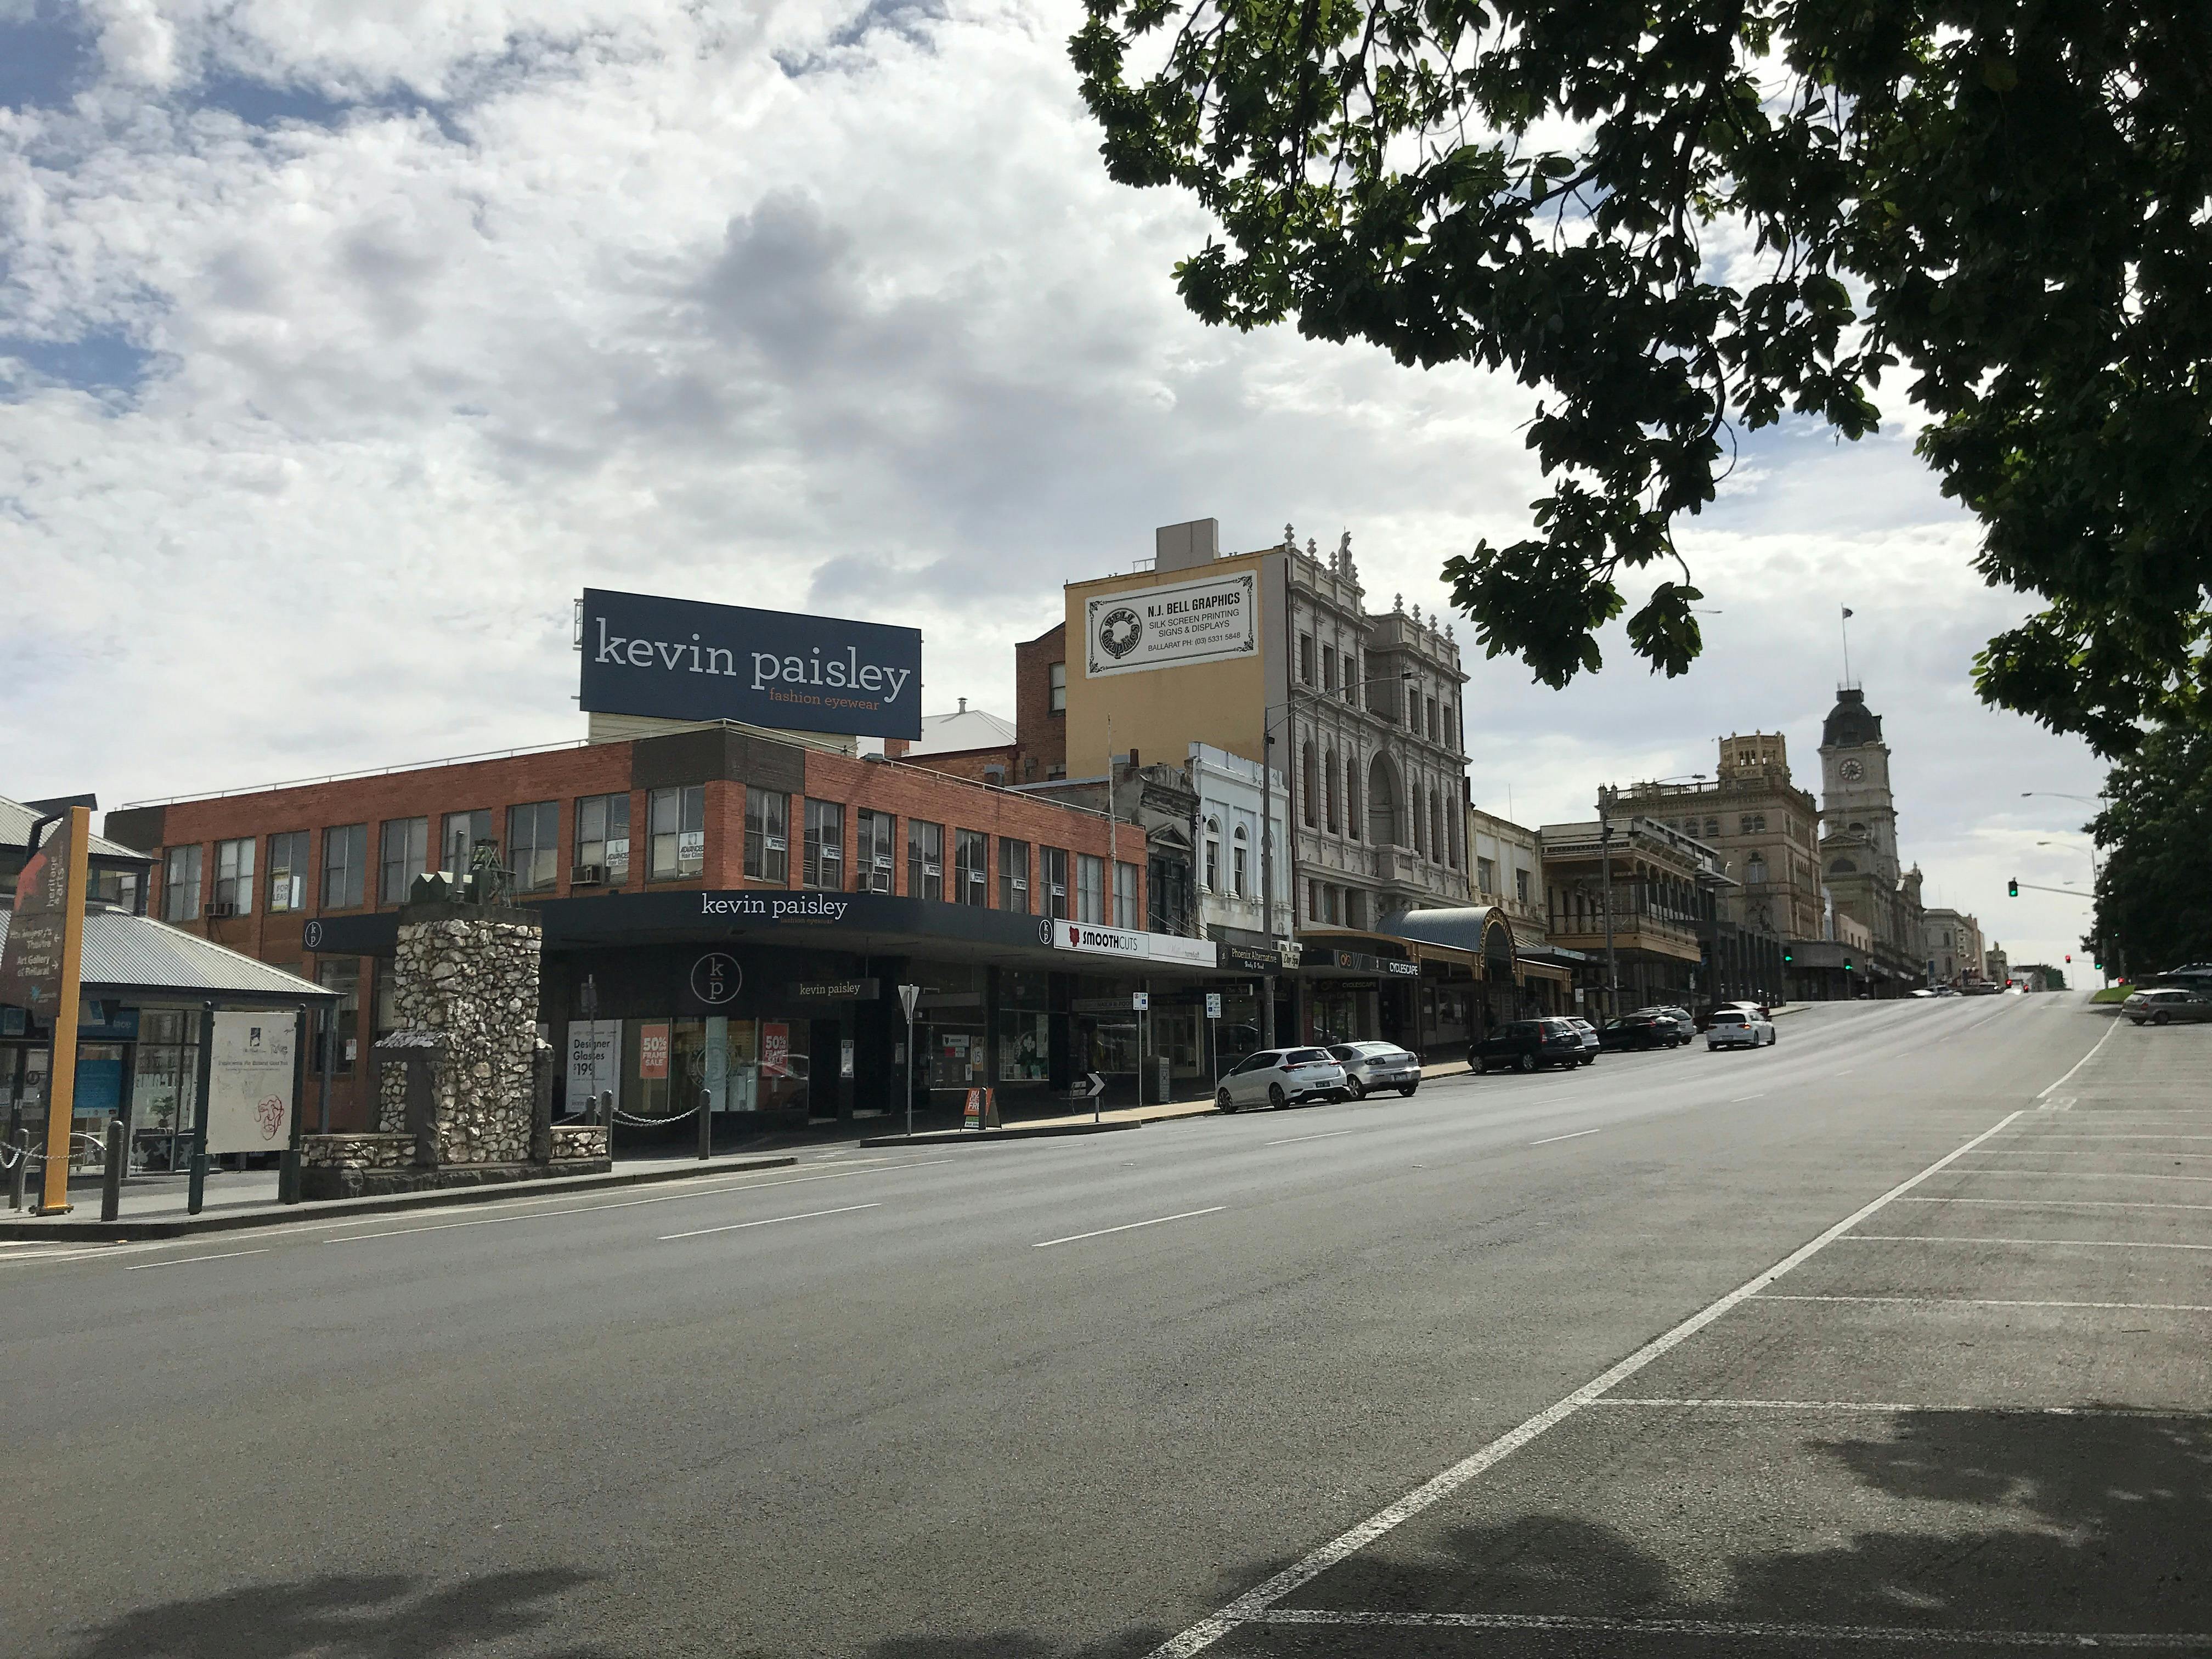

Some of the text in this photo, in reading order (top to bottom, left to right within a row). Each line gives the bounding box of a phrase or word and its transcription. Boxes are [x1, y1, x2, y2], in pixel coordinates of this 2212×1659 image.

[1148, 592, 1240, 617] N.J. BELL GRAPHICS
[1104, 611, 1135, 628] BELL
[1149, 608, 1239, 629] SILK SCREEN PRINTING
[1159, 627, 1183, 637] SIGNS
[1192, 620, 1229, 633] DISPLAYS
[1148, 641, 1180, 651] BALLARAT
[1207, 635, 1223, 643] 5331
[1225, 632, 1240, 640] 5848
[595, 617, 910, 703] kevin paisley
[769, 688, 879, 710] fashion eyewear
[273, 893, 287, 901] LEAS
[702, 893, 848, 920] kevin paisley
[1082, 930, 1137, 951] SMOOTHCUTS
[1232, 948, 1277, 963] Phoenix Alternative
[1389, 962, 1418, 975] CYCLESCAPE
[800, 981, 860, 996] kevin paisley
